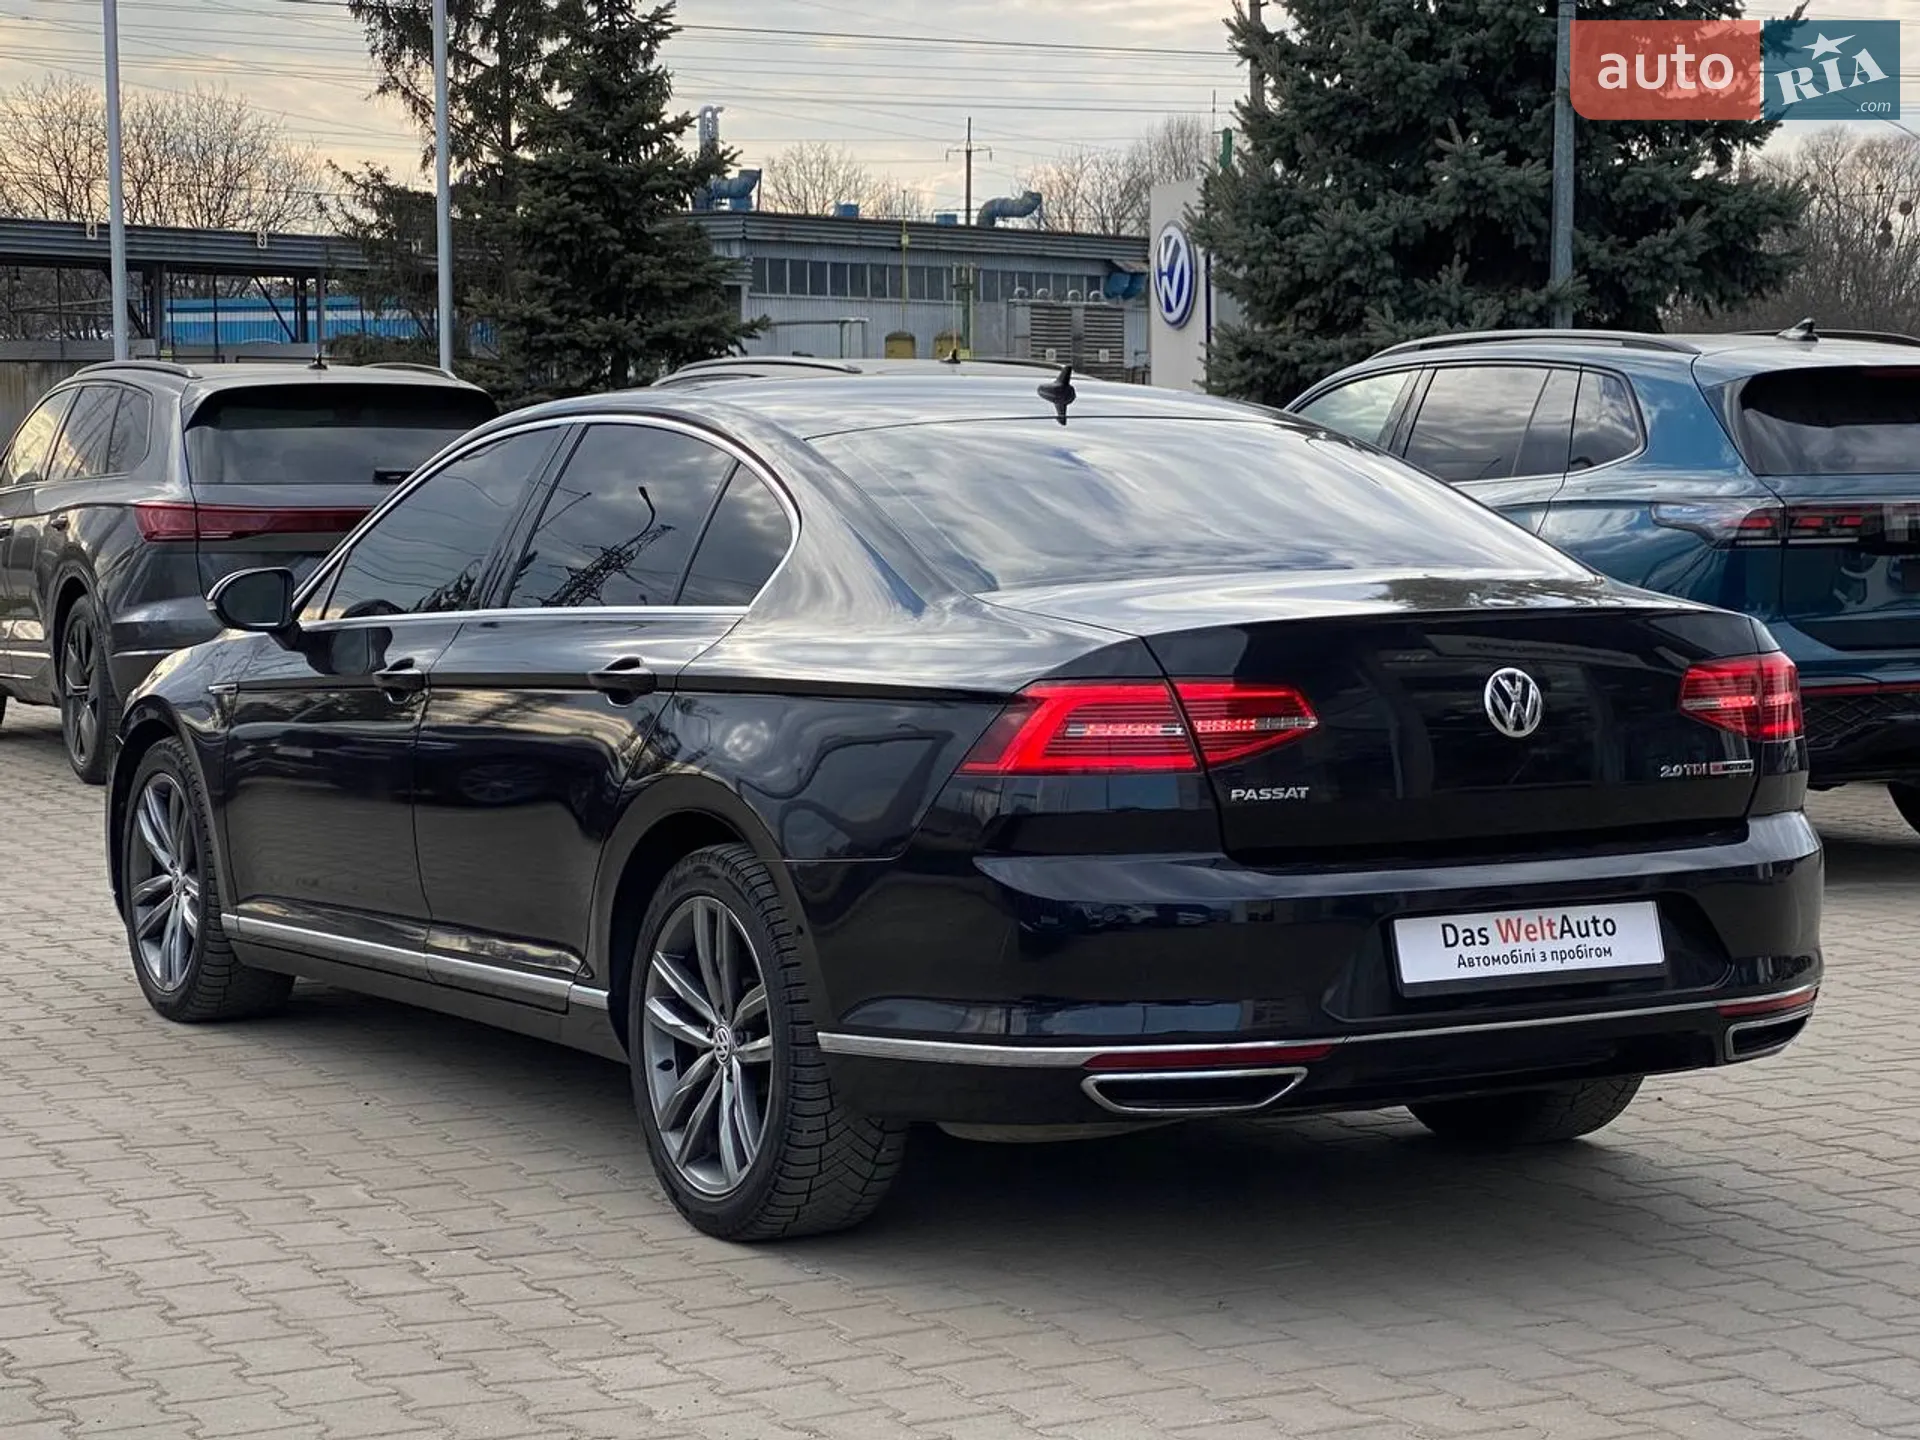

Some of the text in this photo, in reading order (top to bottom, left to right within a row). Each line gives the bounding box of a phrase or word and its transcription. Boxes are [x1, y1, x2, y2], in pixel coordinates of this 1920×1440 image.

[259, 234, 266, 247] 3
[1231, 786, 1310, 801] PASSAT
[1441, 914, 1617, 948] Das WeltAuto
[1457, 943, 1613, 969] Автомобілі з пробігом
